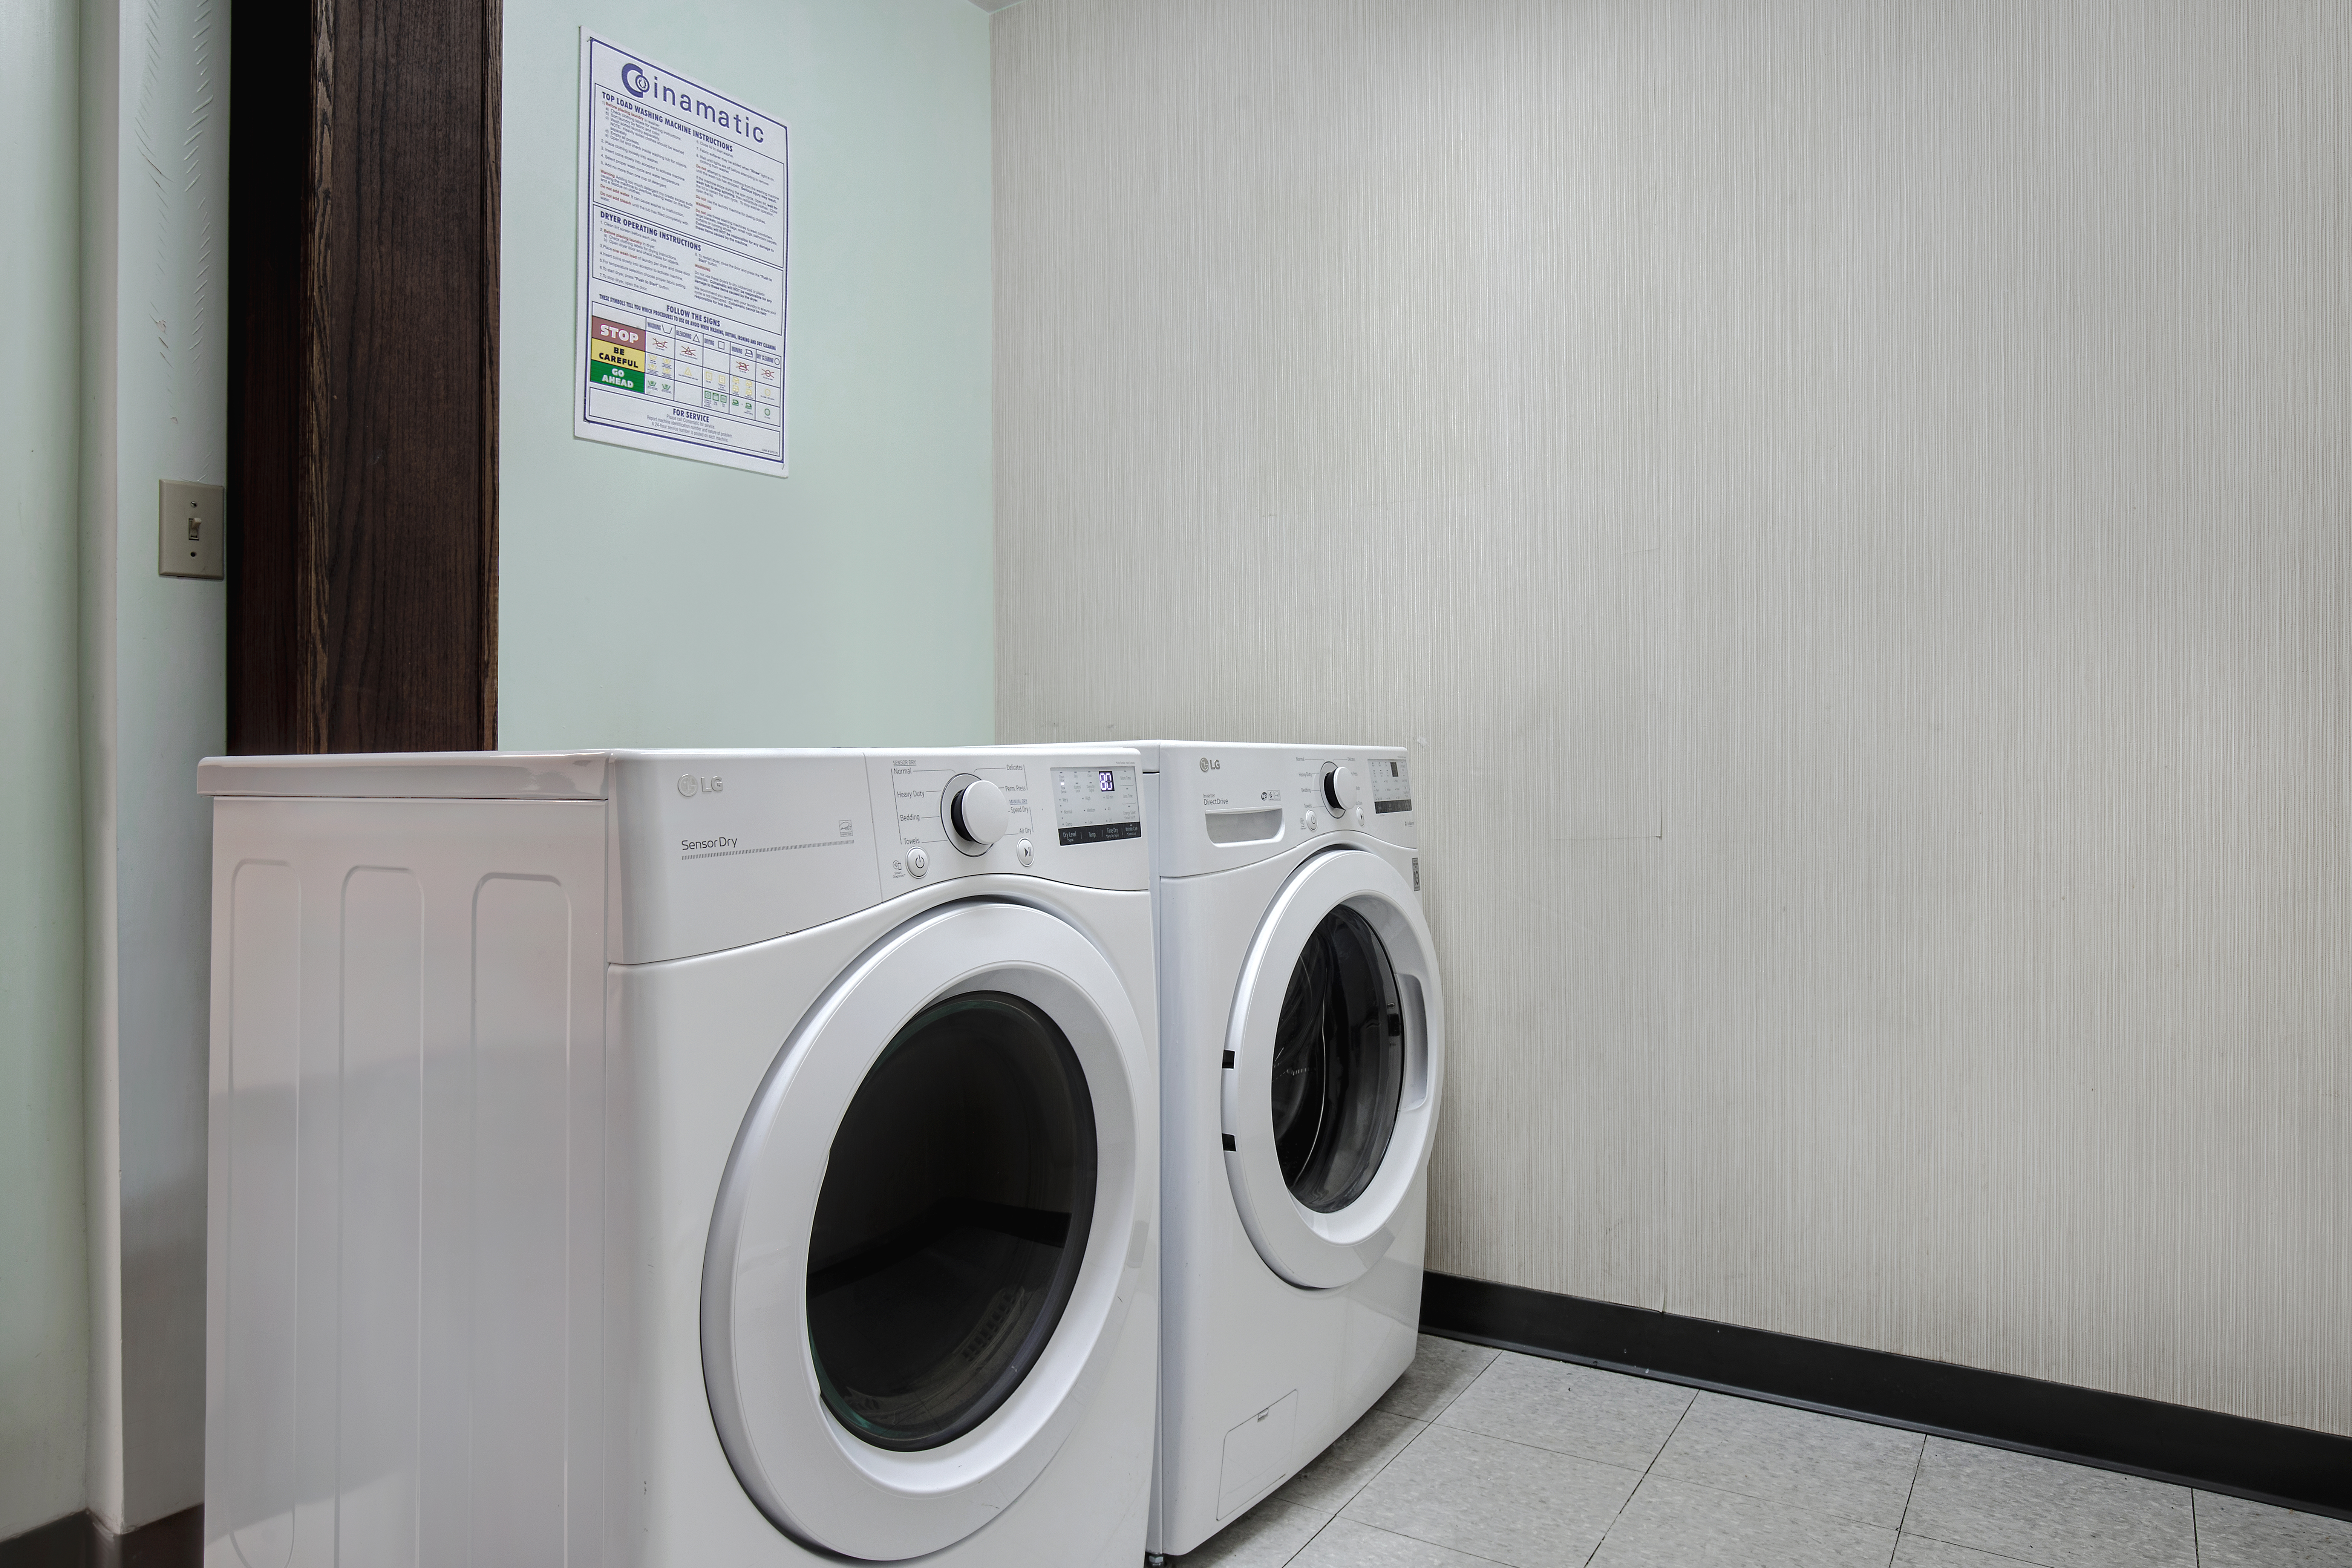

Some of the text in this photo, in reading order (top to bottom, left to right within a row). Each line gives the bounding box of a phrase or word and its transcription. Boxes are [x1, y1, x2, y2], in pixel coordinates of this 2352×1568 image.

[602, 92, 732, 152] TOP LOAD WASHING MACHINE INSTRUCTIONS
[600, 211, 701, 251] DRYER OPERATING INSTRUCTIONS
[610, 297, 625, 306] SYMBOLS
[653, 310, 673, 320] PROCEDURES
[710, 327, 724, 336] WASHING,
[725, 331, 737, 340] DRYING,
[667, 305, 720, 327] FOLLOW THE SIGNS
[600, 323, 639, 345] STOP
[648, 322, 661, 331] WASHING
[676, 330, 691, 339] BLEACHING
[614, 347, 624, 355] BE
[599, 352, 638, 368] CAREFUL
[612, 368, 625, 378] GO
[602, 374, 634, 389] AHEAD
[673, 409, 709, 423] FOR SERVICE
[1210, 760, 1220, 769] LG
[701, 776, 723, 792] LG
